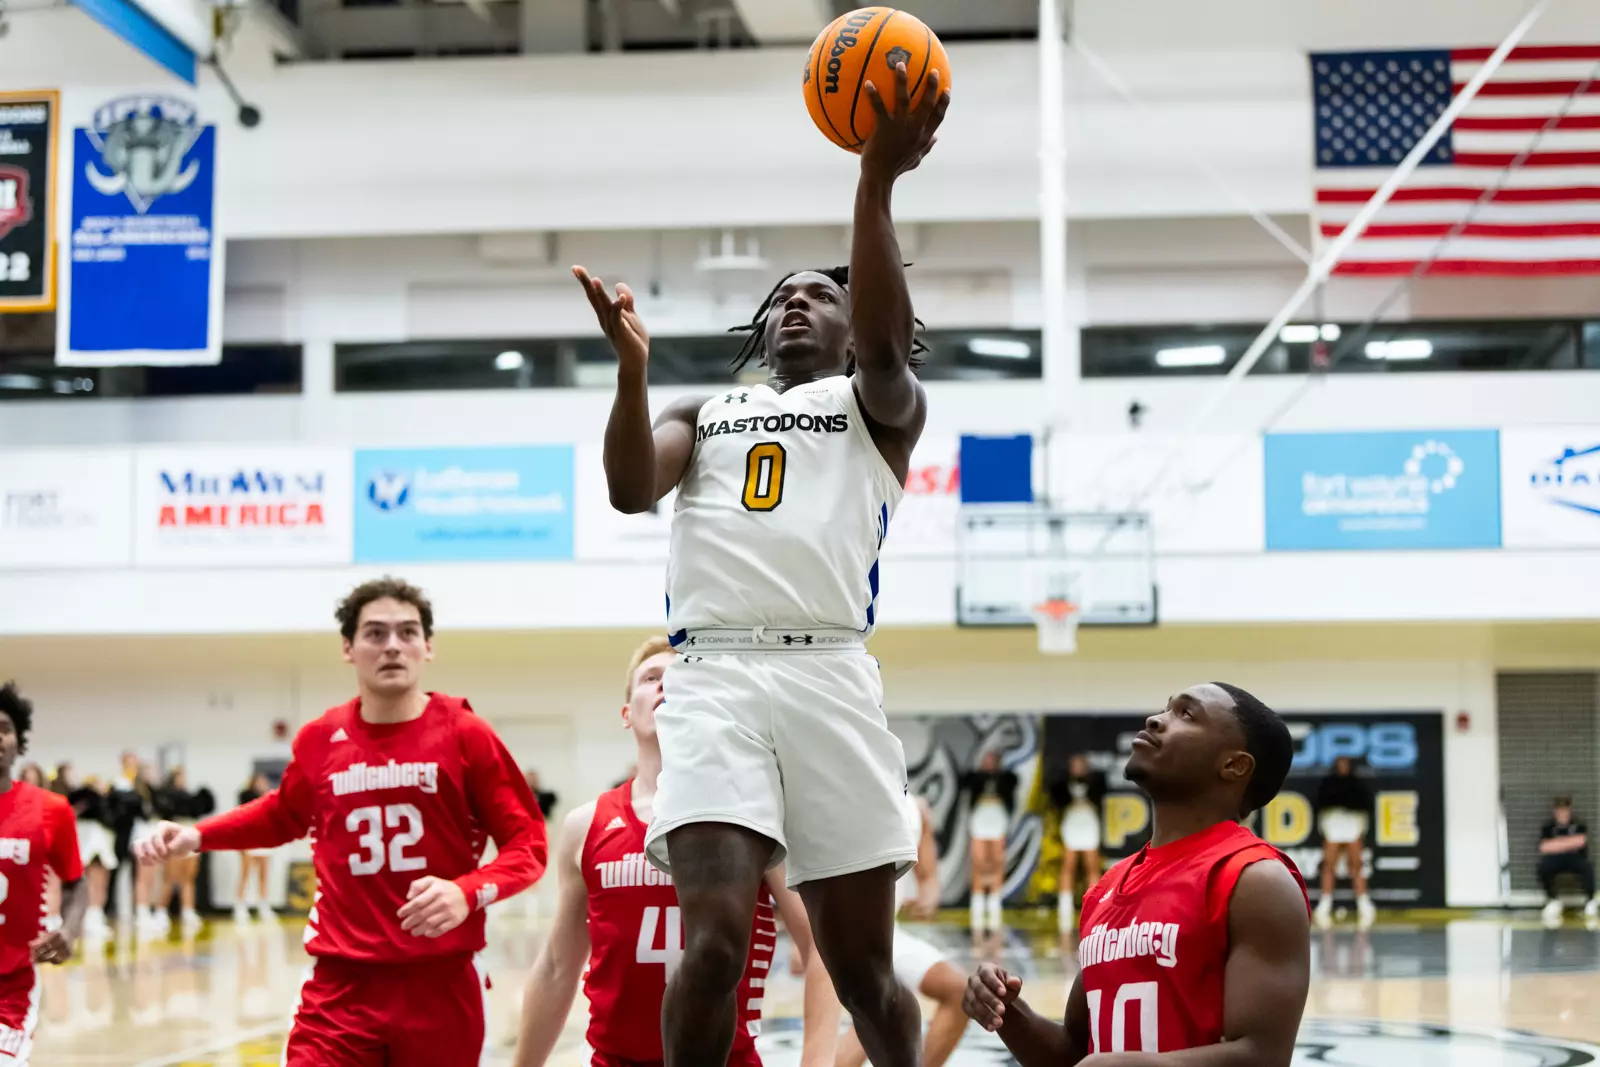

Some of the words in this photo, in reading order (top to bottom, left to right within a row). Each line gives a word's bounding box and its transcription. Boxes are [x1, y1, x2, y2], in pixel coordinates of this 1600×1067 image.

[825, 11, 880, 94] Wilson
[697, 413, 849, 442] MASTODONS
[740, 441, 787, 512] 0
[158, 503, 325, 528] AMERICA
[345, 803, 427, 876] 32
[1086, 981, 1158, 1054] 10
